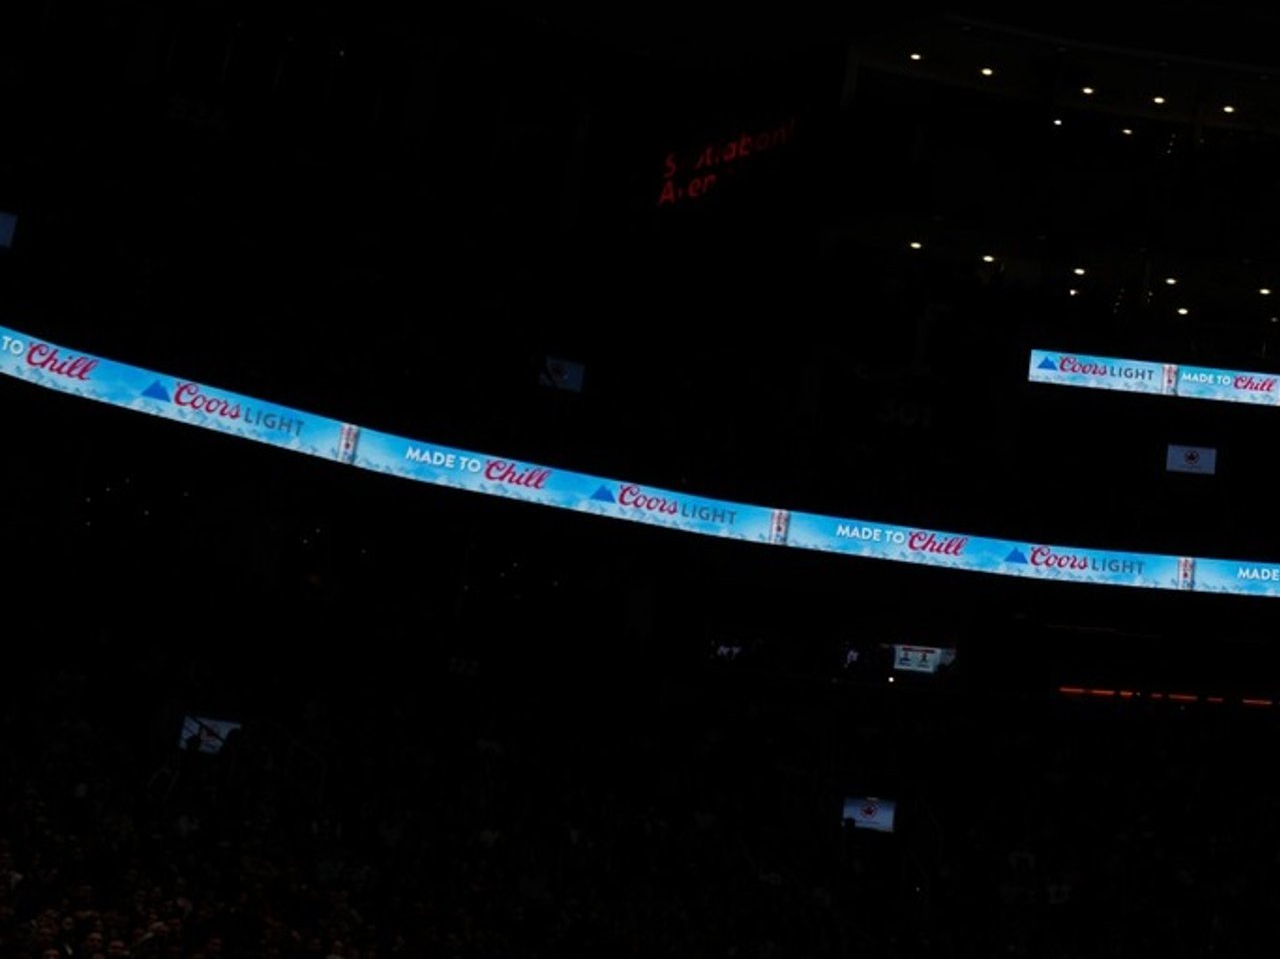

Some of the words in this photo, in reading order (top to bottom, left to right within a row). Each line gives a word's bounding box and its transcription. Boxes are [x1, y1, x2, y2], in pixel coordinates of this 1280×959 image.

[1, 335, 24, 356] TO
[26, 341, 98, 381] Chill
[1058, 356, 1107, 376] Coors
[1109, 365, 1155, 380] LIGHT
[1181, 372, 1213, 385] MADE
[1216, 375, 1232, 386] TO
[1232, 377, 1277, 392] Chill
[174, 381, 242, 419] Coors
[243, 410, 304, 437] LIGHT
[405, 446, 455, 469] MADE
[459, 456, 481, 474] TO
[483, 458, 552, 490] Chill
[618, 483, 679, 515] Coors
[681, 501, 737, 526] LIGHT
[1237, 567, 1279, 582] MADE
